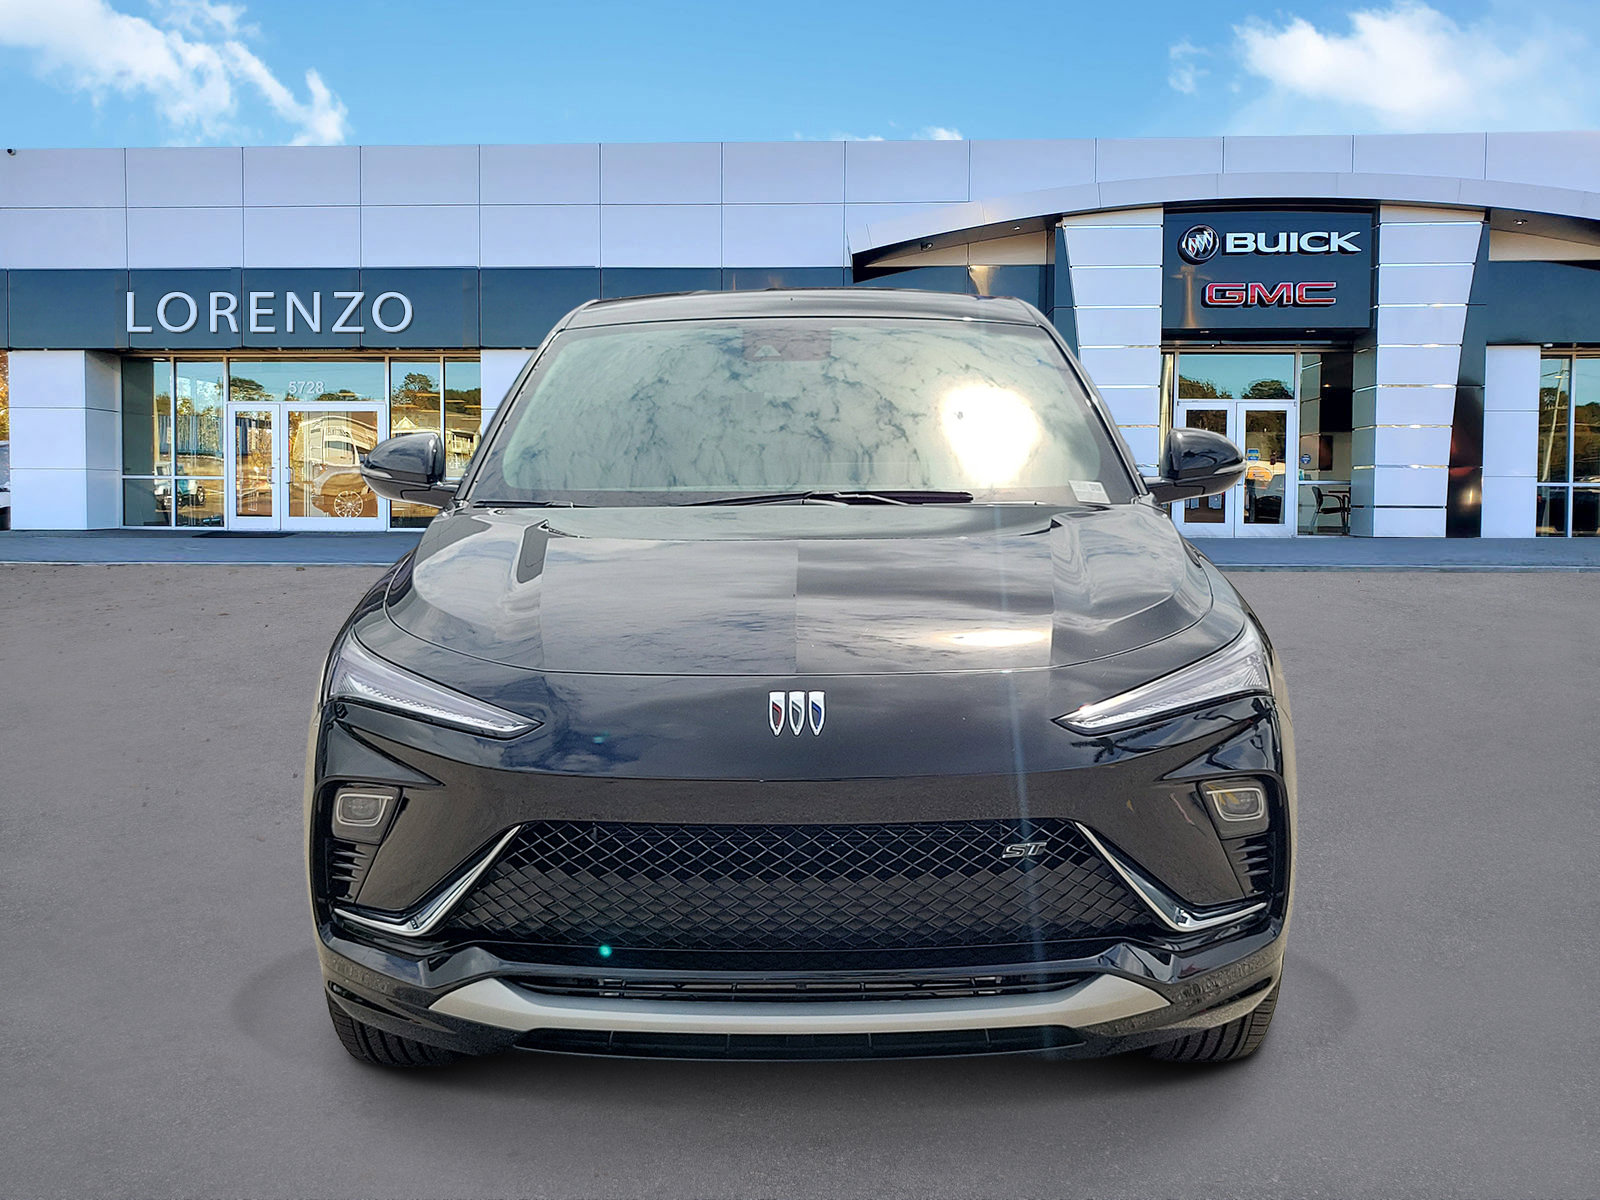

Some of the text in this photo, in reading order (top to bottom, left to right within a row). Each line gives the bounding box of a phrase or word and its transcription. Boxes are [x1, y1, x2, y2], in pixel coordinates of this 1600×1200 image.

[1225, 231, 1362, 254] BUICK
[1205, 282, 1337, 305] GMC
[126, 291, 413, 334] LORENZO
[288, 381, 325, 394] 5728
[1002, 841, 1047, 858] ST
